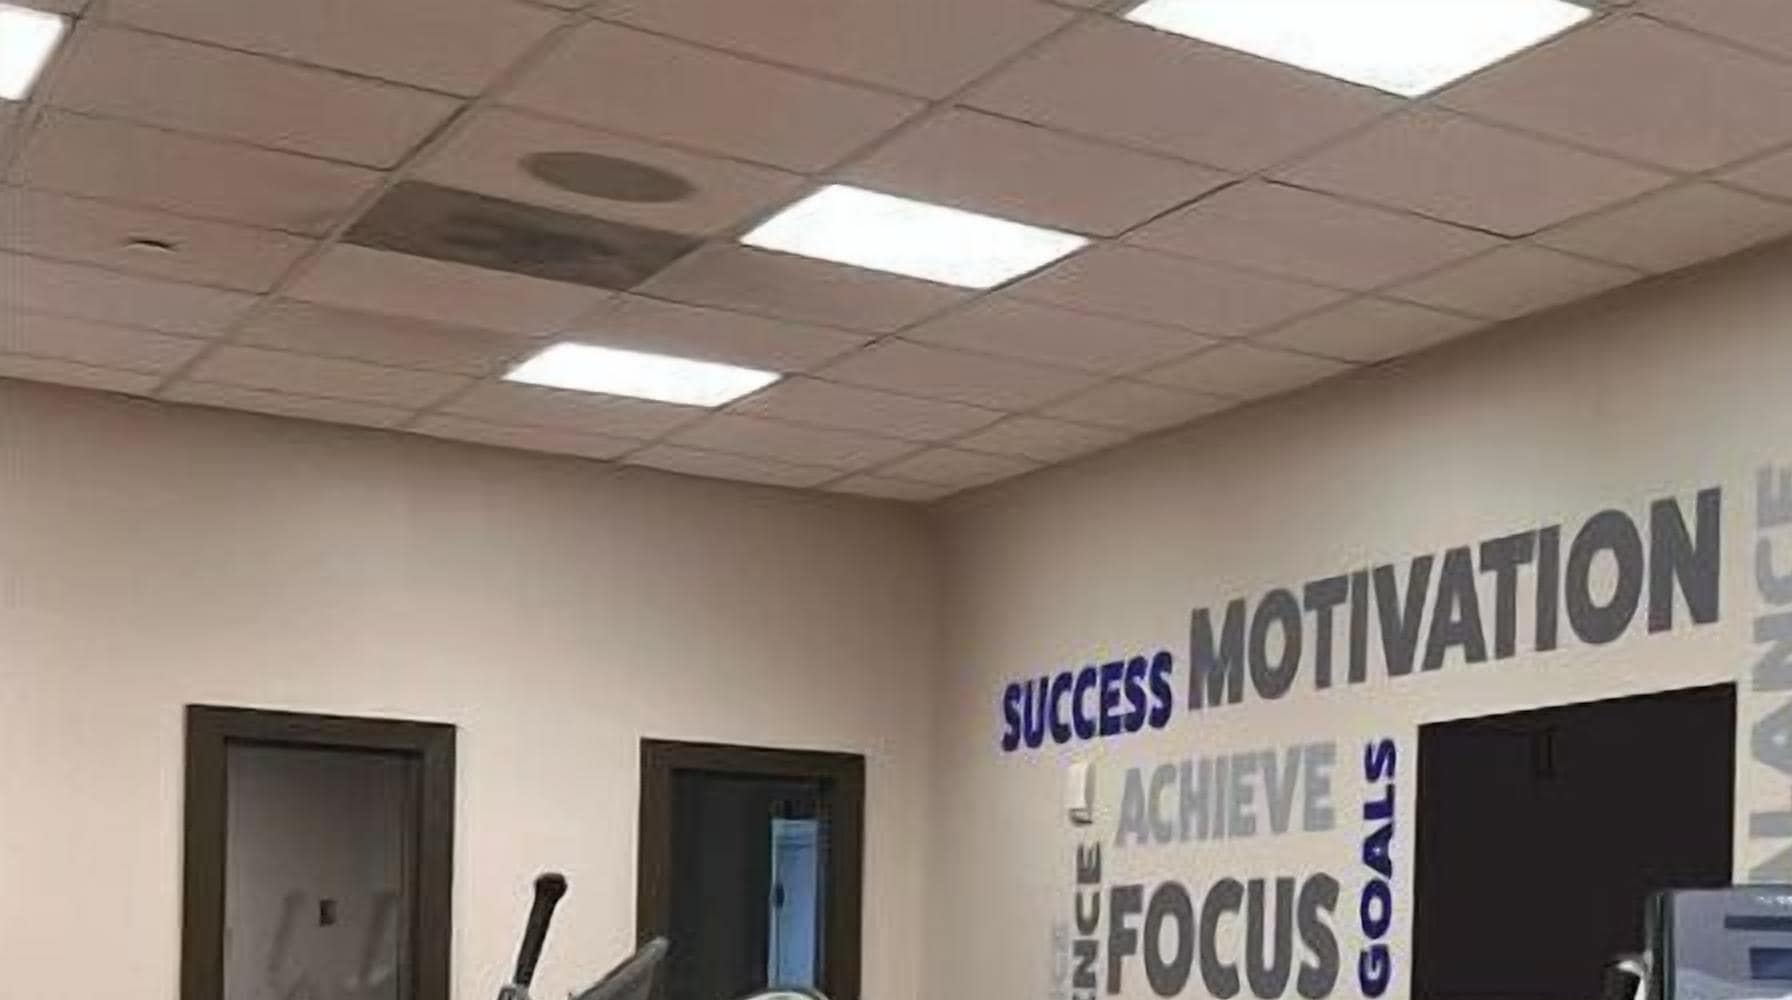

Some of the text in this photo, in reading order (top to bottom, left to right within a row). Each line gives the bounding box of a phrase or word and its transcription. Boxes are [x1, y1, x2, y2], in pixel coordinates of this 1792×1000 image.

[1188, 486, 1722, 710] MOTIVATION
[1001, 650, 1174, 752] SUCCESS
[1114, 742, 1337, 848] ACHIEVE
[1357, 738, 1397, 1000] GOALS
[1105, 871, 1341, 1000] FOCUS
